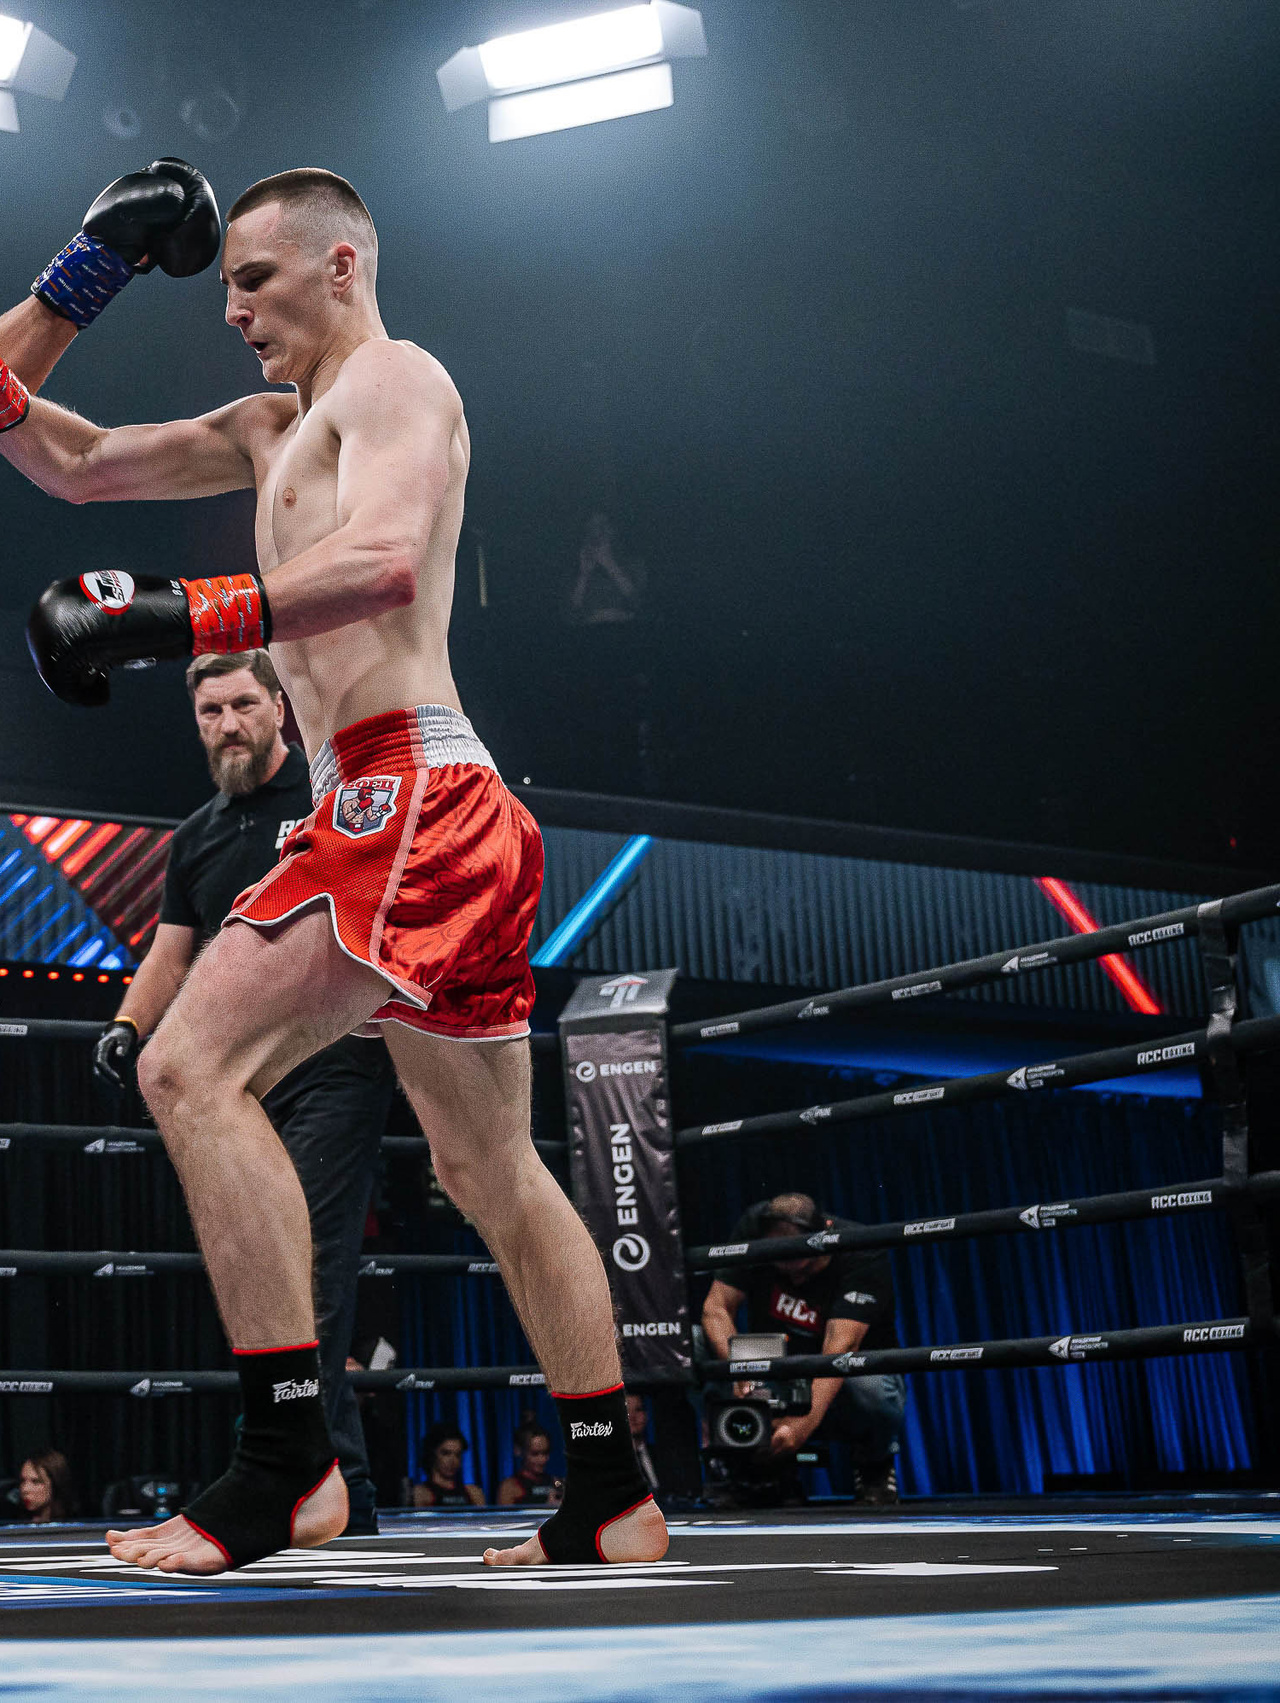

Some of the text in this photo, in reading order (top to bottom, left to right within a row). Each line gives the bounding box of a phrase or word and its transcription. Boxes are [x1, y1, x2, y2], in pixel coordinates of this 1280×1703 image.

[1137, 1049, 1161, 1065] RCC
[599, 1061, 657, 1077] ENGEN
[610, 1122, 639, 1226] ENGEN
[1151, 1194, 1176, 1209] RCC
[622, 1321, 682, 1337] ENGEN
[1183, 1327, 1209, 1342] RCC
[570, 1420, 614, 1440] Fairtex
